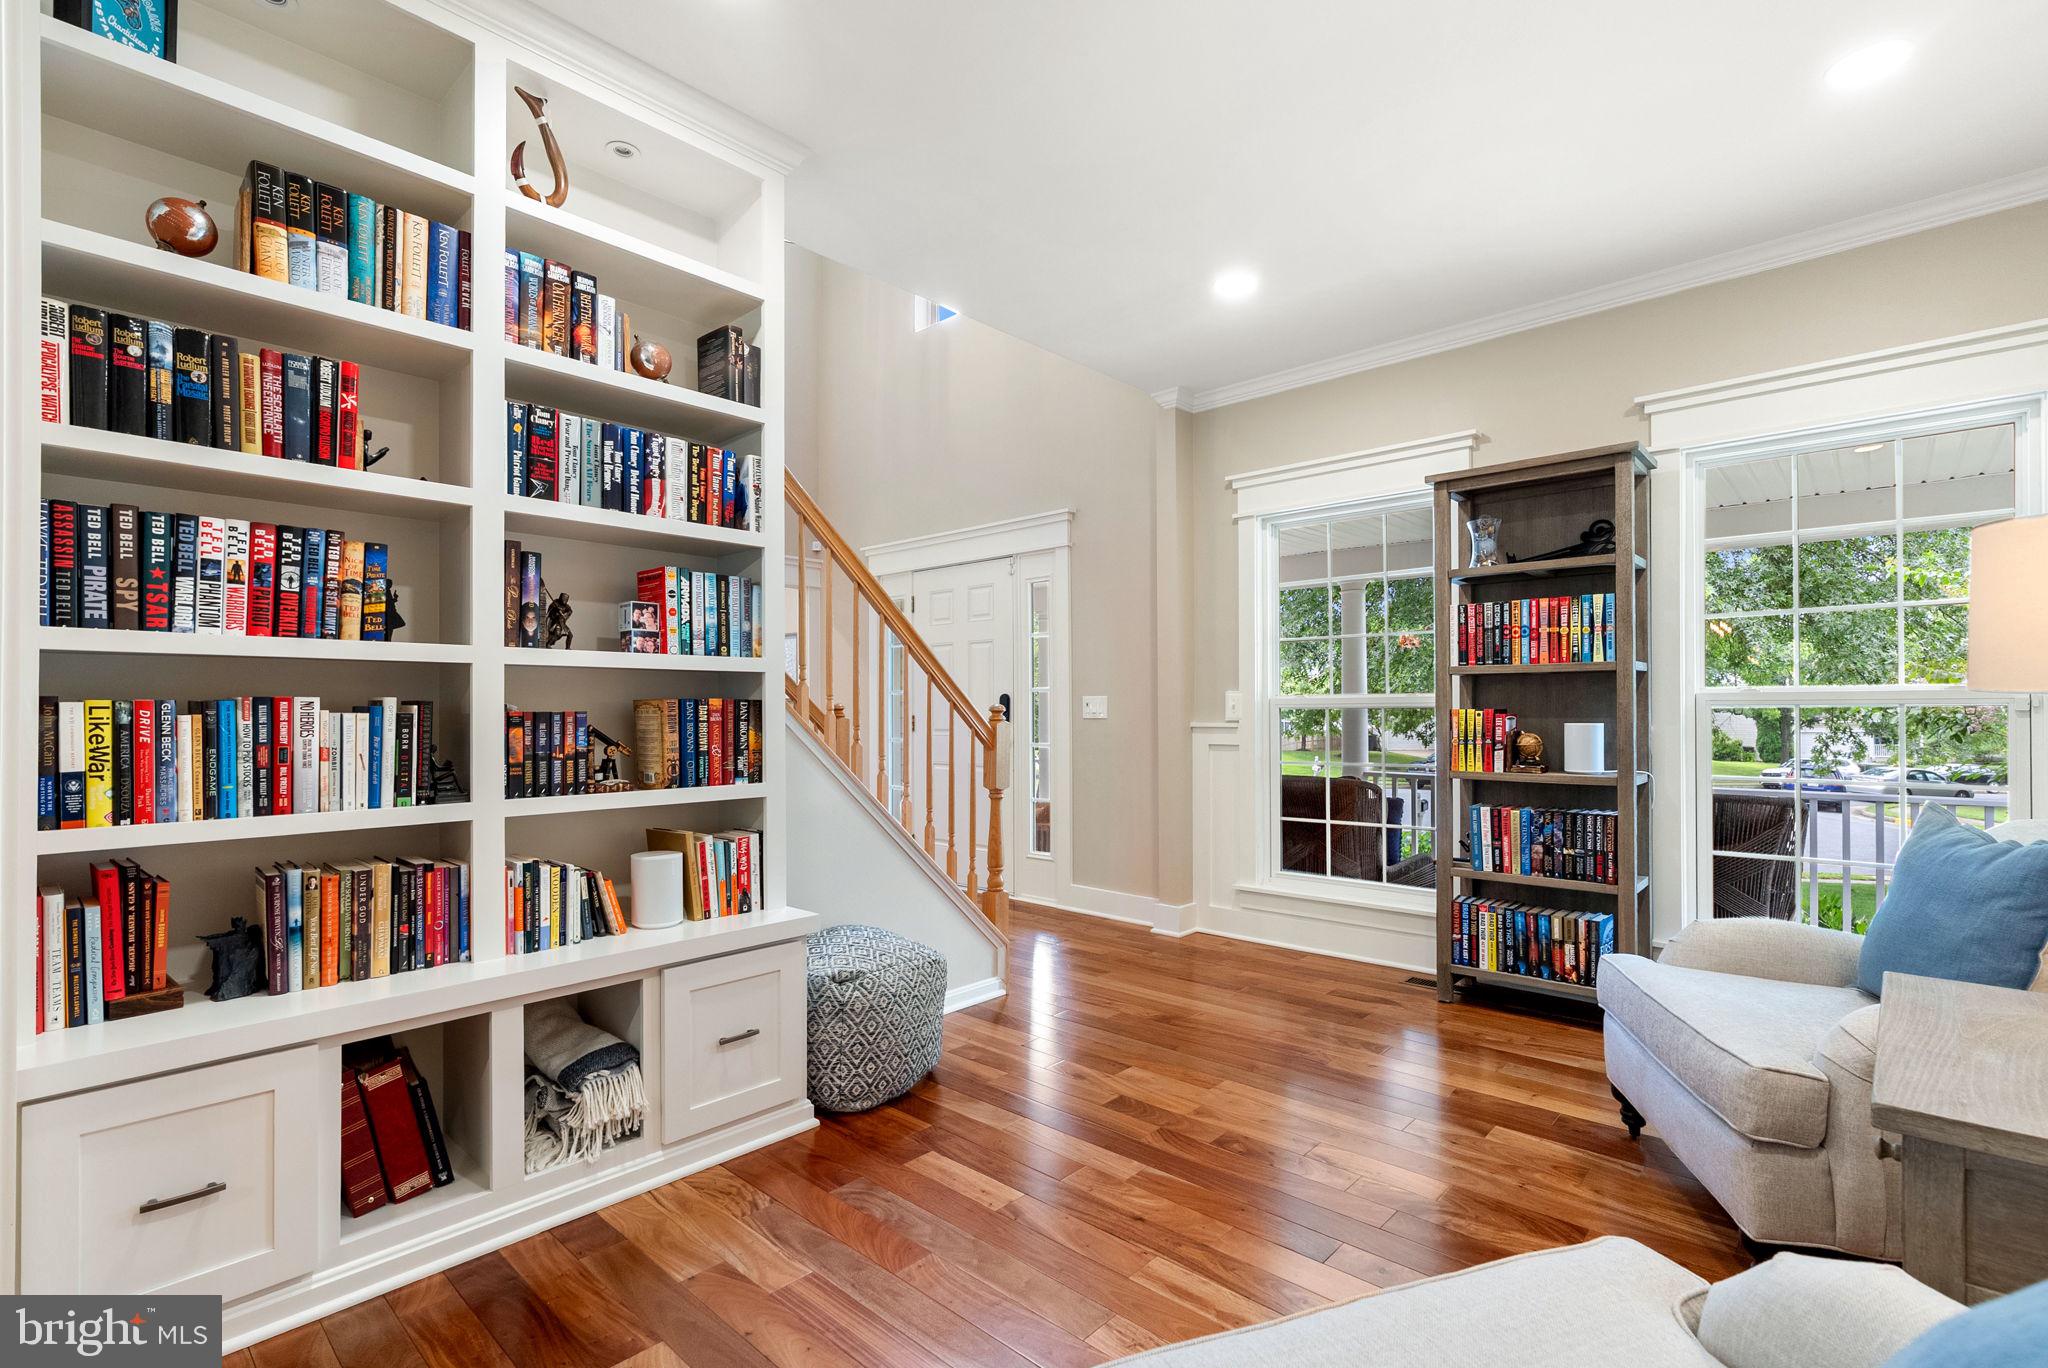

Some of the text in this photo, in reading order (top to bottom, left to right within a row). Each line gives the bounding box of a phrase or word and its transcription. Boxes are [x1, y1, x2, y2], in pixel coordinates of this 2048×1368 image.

[258, 171, 284, 214] KEN FOLLETT
[289, 182, 311, 219] KEN FOLLETT
[321, 194, 344, 233] KEN FOLLETT
[358, 223, 369, 264] FOLLETT
[411, 221, 423, 280] KEN FOLLETT
[438, 229, 450, 288] KEN FOLLETT
[552, 282, 565, 342] OATHBRINGER
[41, 340, 57, 393] APOCALYPSE
[176, 352, 206, 366] Robert
[177, 359, 209, 374] Ludlum
[273, 376, 283, 391] THE
[41, 394, 58, 425] WATCH
[628, 446, 639, 467] Clancy
[631, 431, 639, 444] Tom
[630, 469, 639, 484] Debt
[726, 458, 736, 472] Tom
[53, 504, 75, 569] ASSASSIN
[87, 509, 102, 559] TED BELL
[119, 510, 133, 559] TED BELL
[151, 515, 164, 564] TED BELL
[178, 520, 195, 573] TED BELL
[200, 521, 212, 557] BELL
[211, 527, 223, 553] TED
[227, 526, 238, 557] BELL
[237, 531, 247, 554] TED
[254, 529, 265, 560] BELL
[263, 534, 274, 557] TED
[281, 532, 293, 564] BELL
[290, 538, 302, 561] TED
[56, 572, 71, 621] TED BELL
[84, 565, 107, 619] PIRATE
[115, 577, 139, 612] SPY
[146, 582, 168, 628] TSAR
[174, 577, 195, 627] WARLORD
[198, 582, 221, 629] PHANTOM
[225, 587, 246, 630] WARRIORS
[251, 588, 271, 628] PATRIOT
[278, 592, 299, 637] OVERKILL
[299, 712, 315, 738] HEROES
[300, 701, 315, 711] NO
[739, 702, 749, 749] DAN BROWN
[43, 704, 56, 766] John McCain
[88, 706, 111, 781] LikeWar
[161, 703, 172, 762] GLENN BECK
[242, 724, 252, 739] HOW
[242, 741, 252, 749] TO
[401, 729, 409, 750] BORN
[686, 723, 694, 752] BROWN
[698, 705, 708, 751] DAN BROWN
[120, 730, 131, 769] AMERICA
[209, 749, 217, 797] ENDGAME
[242, 765, 252, 787] STOCKS
[552, 870, 560, 913] WOODEN
[359, 906, 368, 924] GOD
